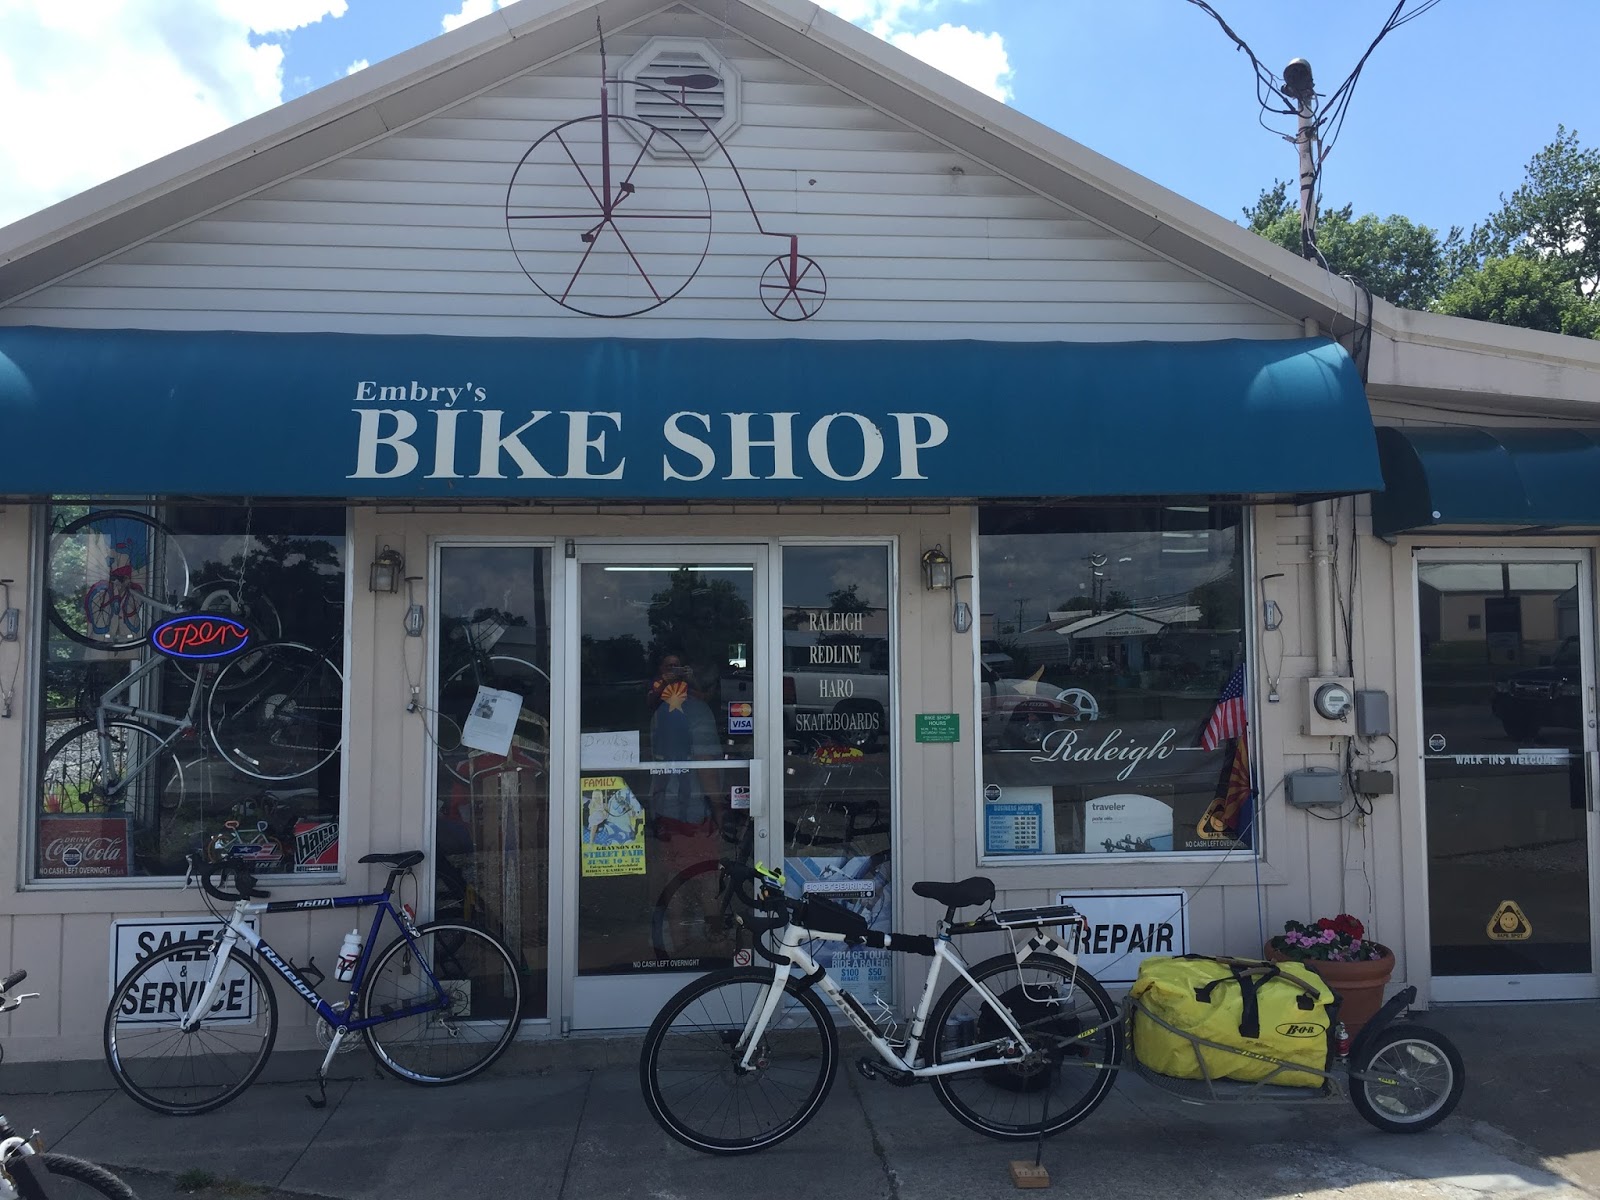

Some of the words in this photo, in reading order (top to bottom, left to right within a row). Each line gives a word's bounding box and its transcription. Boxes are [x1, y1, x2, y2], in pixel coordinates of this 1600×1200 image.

[353, 379, 487, 408] Embry's
[345, 408, 626, 480] BIKE
[662, 410, 949, 483] SHOP
[809, 612, 863, 631] RALEIGH
[809, 645, 861, 664] REDLINE
[819, 679, 854, 698] HARO
[732, 720, 752, 728] VISA
[795, 712, 880, 732] SKATEBOARDS
[1029, 728, 1176, 781] Raleigh
[1455, 754, 1506, 765] WALK-INS
[1510, 754, 1557, 765] WELCOME
[583, 778, 617, 788] FAMILY
[1092, 802, 1126, 811] traveler
[1185, 840, 1192, 848] NO
[1193, 840, 1207, 848] CASH
[583, 850, 619, 858] STREET
[621, 849, 644, 857] FAIR
[39, 867, 47, 875] NO
[48, 867, 64, 875] CASH
[64, 867, 78, 875] LEFT
[79, 866, 111, 874] OVERNIGHT
[833, 882, 873, 890] BEARINGS
[1073, 923, 1174, 955] REPAIR
[832, 951, 851, 960] 2014
[852, 951, 869, 959] GET
[869, 950, 886, 959] OUT
[670, 959, 700, 967] OVERNIGHT
[832, 960, 851, 968] RIDE
[852, 960, 859, 968] A
[180, 965, 187, 978] &
[260, 946, 319, 1003] Raleigh
[841, 968, 859, 977] $100
[868, 968, 882, 976] $50
